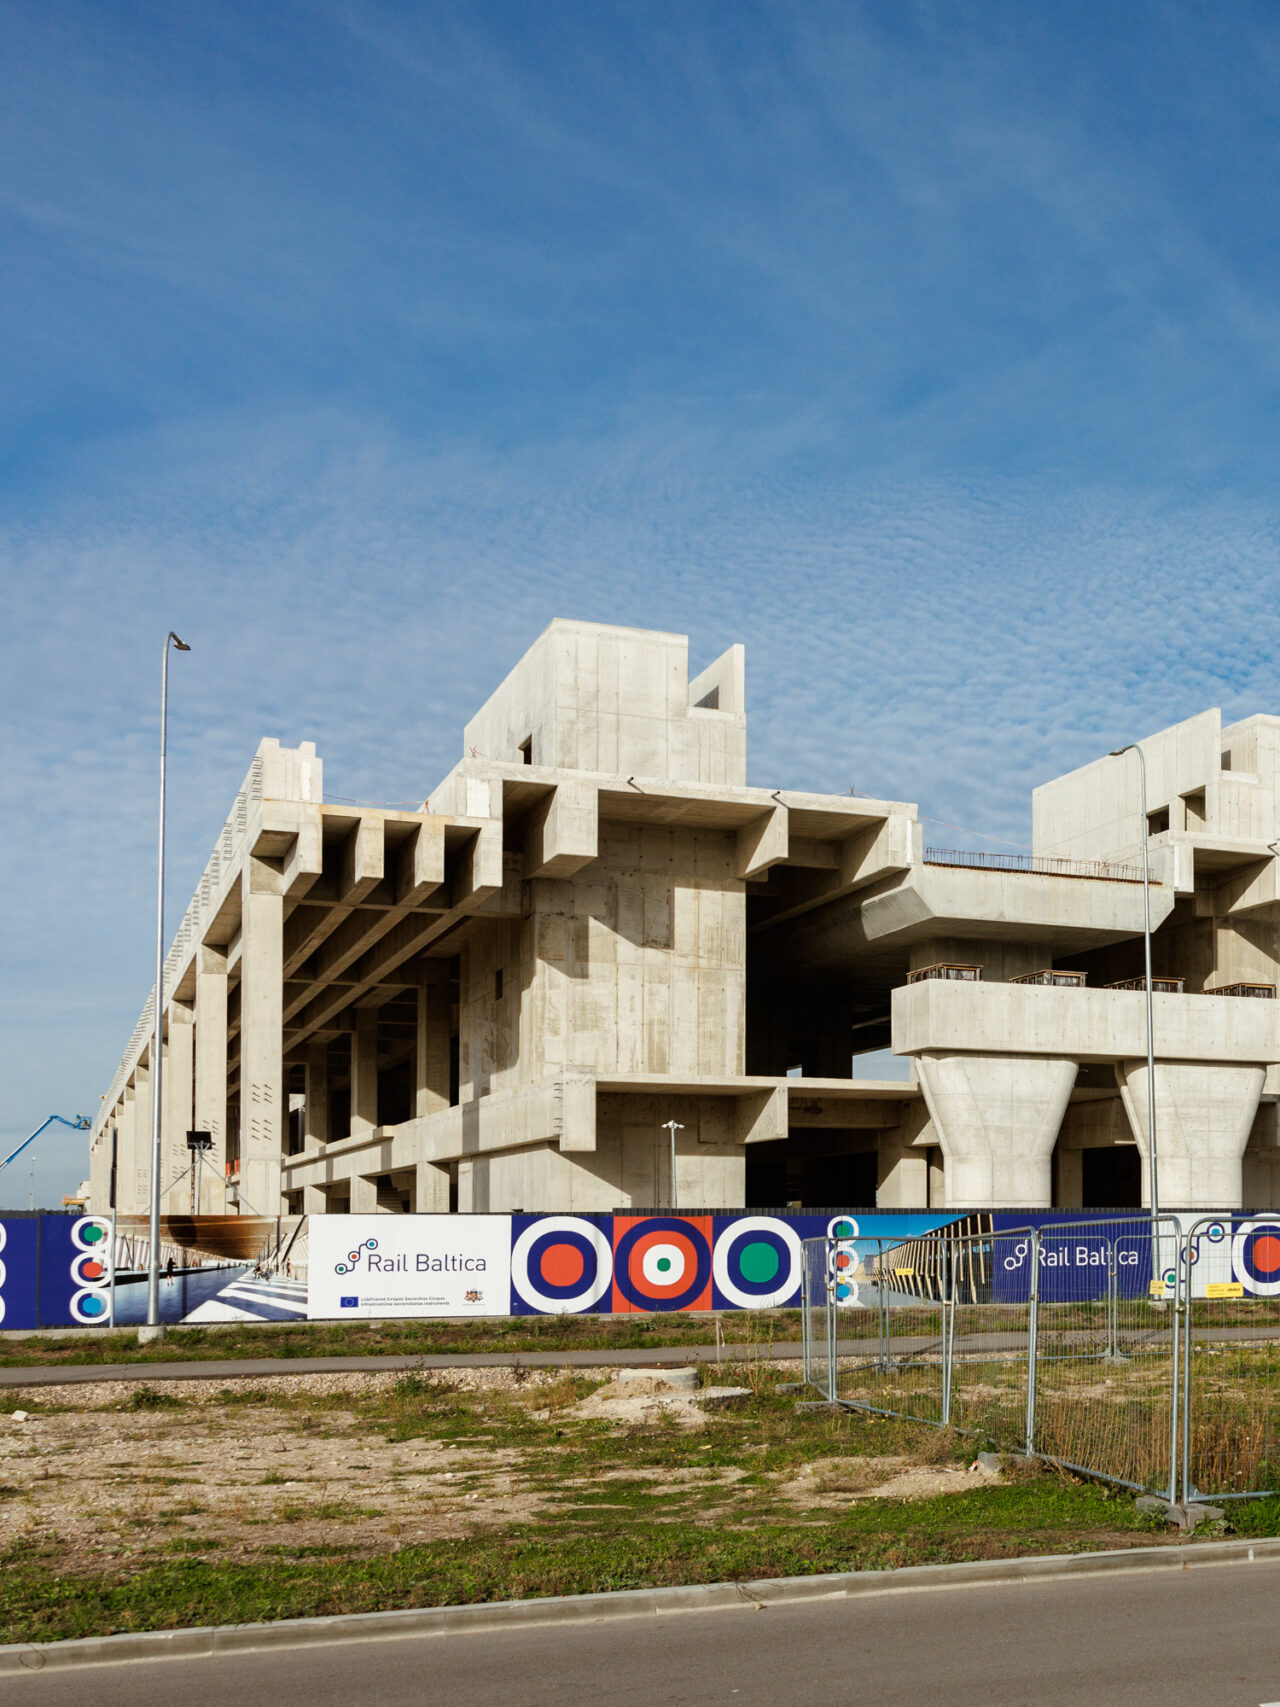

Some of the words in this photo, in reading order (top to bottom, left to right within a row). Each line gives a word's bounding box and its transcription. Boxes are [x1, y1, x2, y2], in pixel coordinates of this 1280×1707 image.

[368, 1253, 408, 1272] Rail
[416, 1253, 487, 1272] Baltica
[1038, 1246, 1070, 1267] Rail
[1076, 1246, 1139, 1266] Balca
